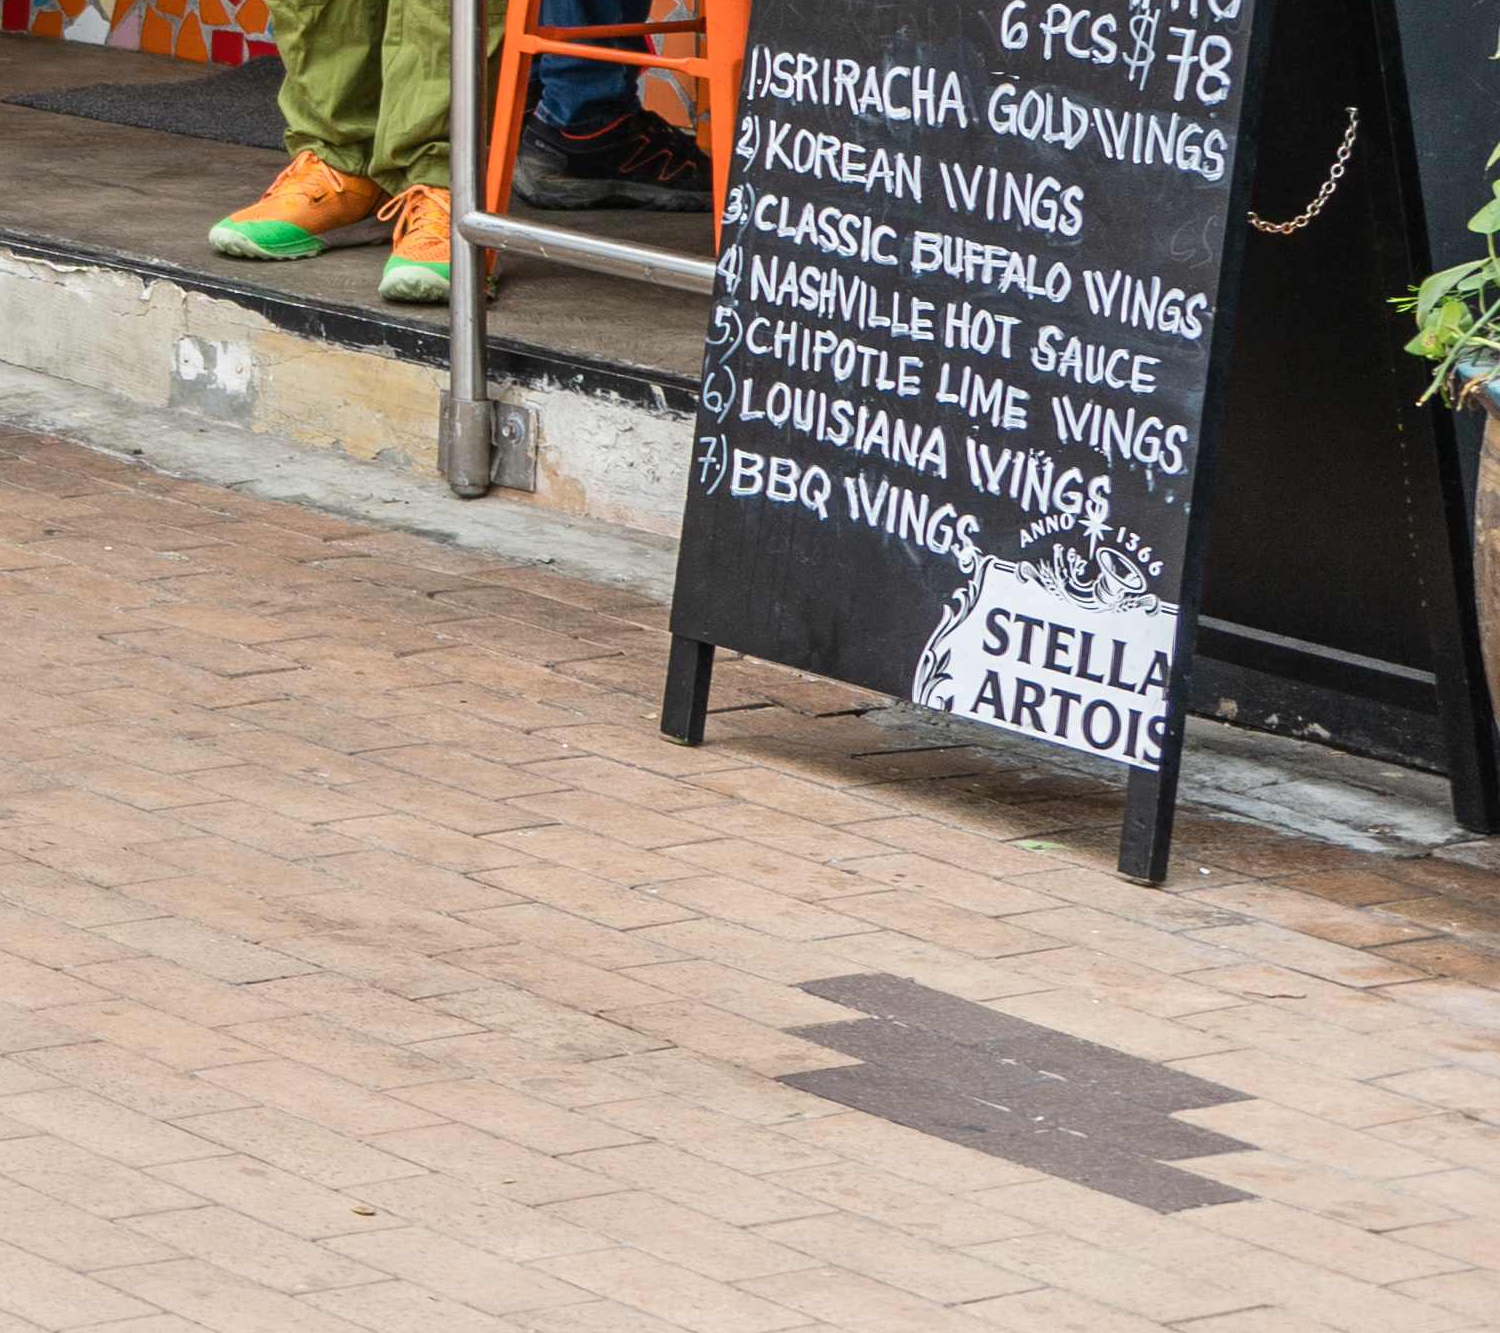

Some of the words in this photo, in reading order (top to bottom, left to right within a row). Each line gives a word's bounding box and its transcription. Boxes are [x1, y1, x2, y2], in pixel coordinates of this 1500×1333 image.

[1000, 0, 1028, 50] 6
[1039, 2, 1117, 64] PCS
[1121, 8, 1233, 105] $78
[768, 51, 968, 129] SRIRACHA
[988, 82, 1090, 150] GOLD
[1090, 106, 1229, 182] WINGS
[765, 120, 922, 203] KOREAN
[940, 162, 1085, 237] WINGS
[750, 254, 934, 342] NASHVILLE
[945, 303, 1022, 358] HOT
[1031, 324, 1160, 394] SAUCE
[754, 193, 898, 265] CLASSIC
[911, 231, 1072, 304] BUFFALO
[1083, 269, 1208, 340] WINGS
[740, 378, 948, 479] LOUISIANA
[967, 436, 1112, 521] WINGS
[745, 317, 921, 397] CHIPOTLE
[937, 365, 1030, 430] LIME
[1052, 397, 1189, 475] WINGS
[731, 448, 831, 519] BBQ
[845, 475, 980, 570] WINGS
[1019, 514, 1076, 548] ANNO
[1116, 527, 1165, 578] 1366
[982, 607, 1171, 700] STELLA
[969, 670, 1166, 765] ARTOIS
